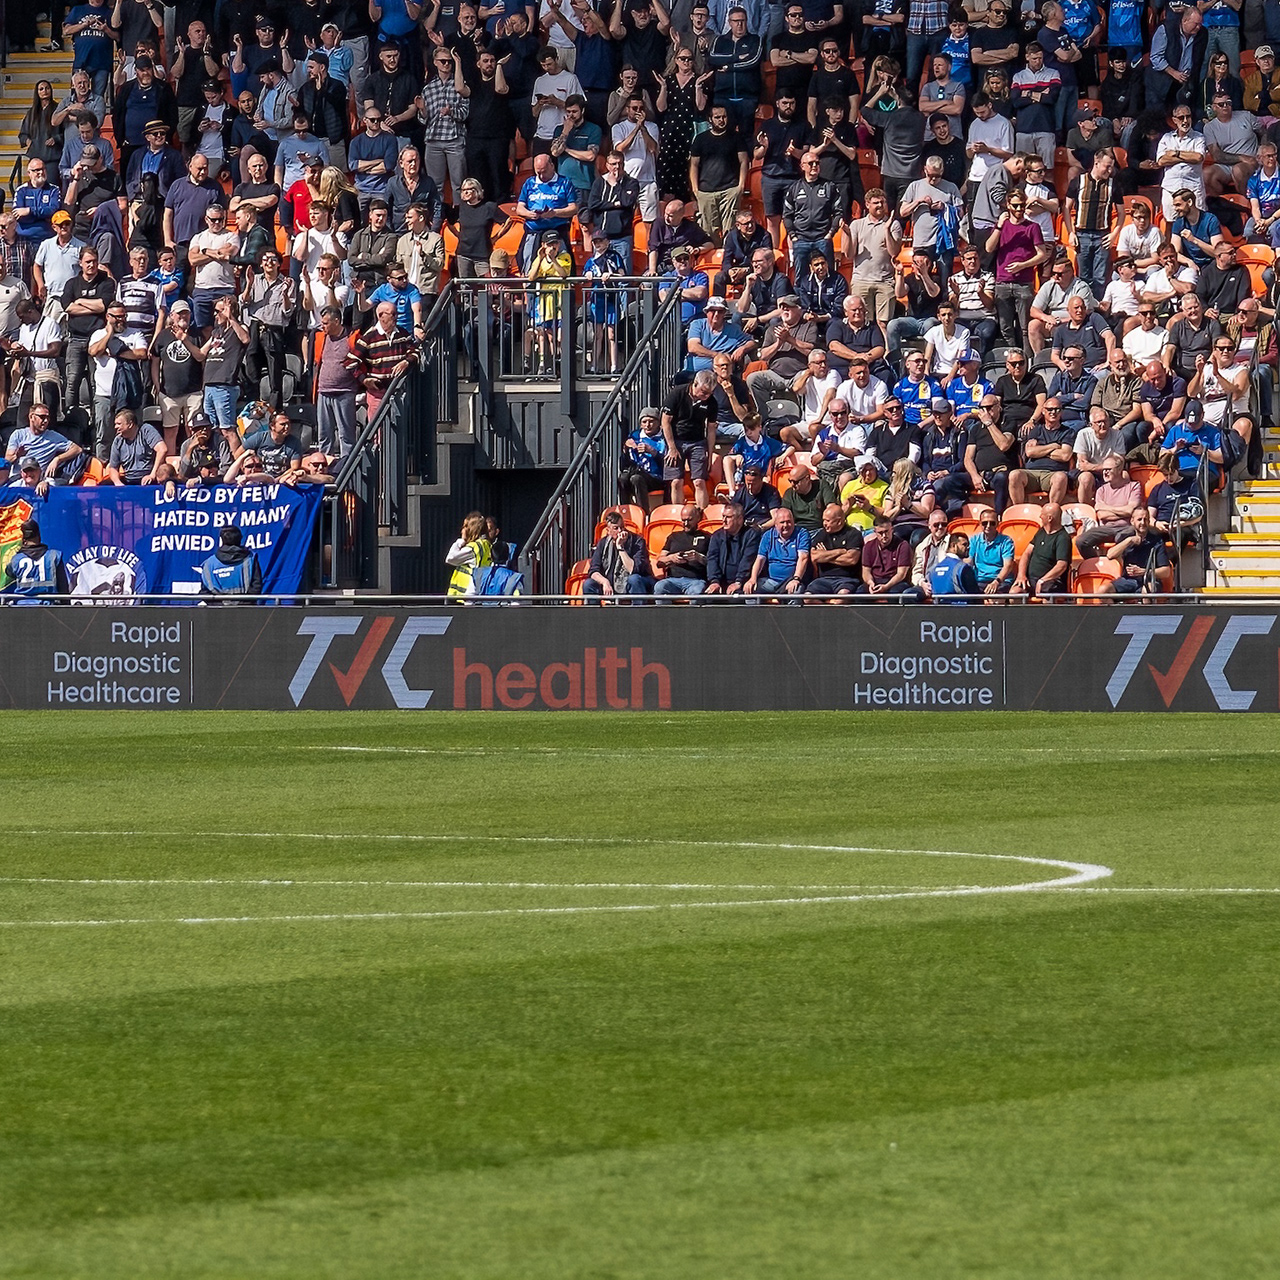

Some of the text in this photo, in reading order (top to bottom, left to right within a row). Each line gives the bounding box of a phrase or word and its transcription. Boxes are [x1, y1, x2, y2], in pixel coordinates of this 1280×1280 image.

[1268, 453, 1274, 461] E
[214, 488, 238, 504] BY
[242, 484, 280, 502] FEW
[154, 504, 290, 528] HATED BY MANY
[1242, 504, 1249, 514] D
[151, 535, 214, 552] ENVIED
[245, 532, 272, 550] ALL
[18, 556, 46, 584] 21
[66, 545, 140, 574] A WAY OF LIFE
[1218, 560, 1224, 568] C
[111, 622, 181, 648] Rapid
[920, 621, 993, 648] Rapid
[54, 651, 181, 678] Diagnostic
[860, 651, 993, 678] Diagnostic
[452, 646, 672, 710] health
[48, 681, 181, 704] Healthcare
[854, 681, 993, 706] Healthcare
